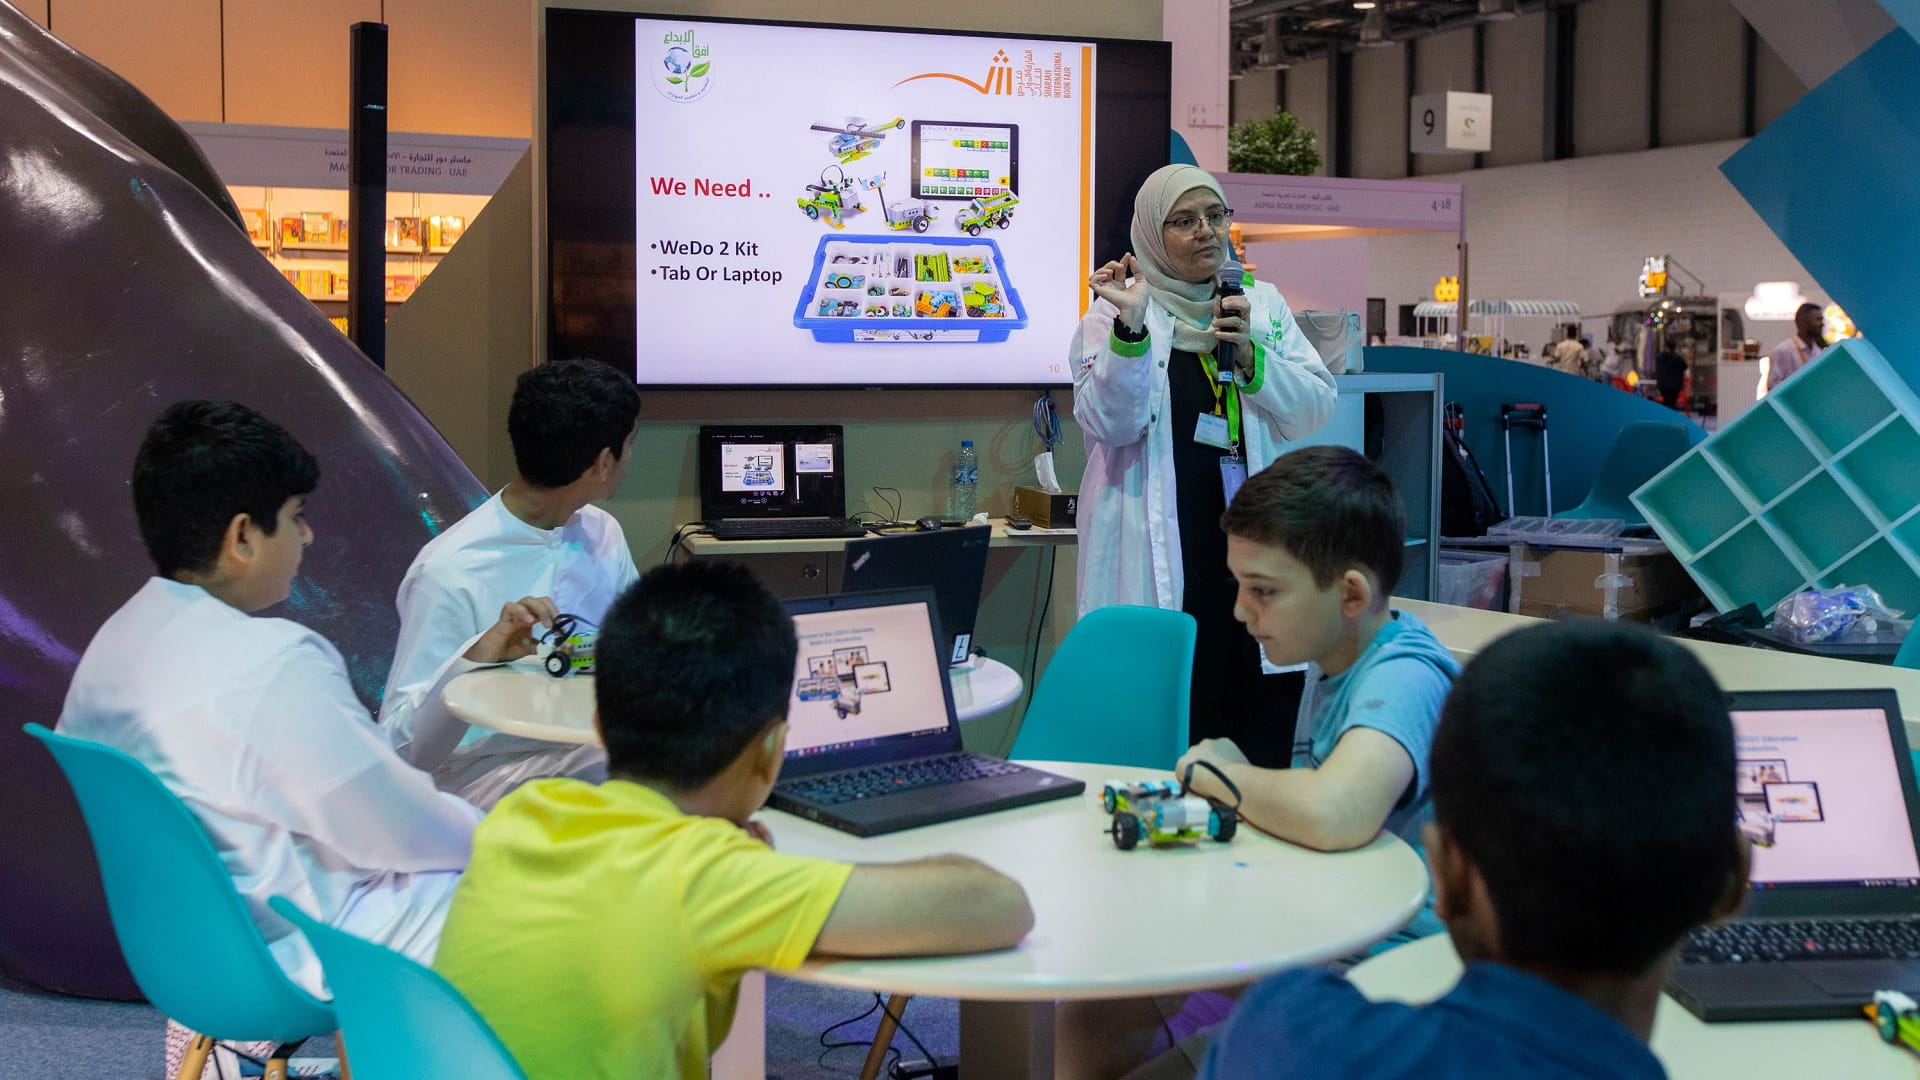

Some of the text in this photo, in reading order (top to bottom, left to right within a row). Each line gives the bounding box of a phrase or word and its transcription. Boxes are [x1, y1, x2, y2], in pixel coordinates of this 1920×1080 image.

[1044, 69, 1052, 98] SHARJAH
[1053, 52, 1062, 98] INTERNATIONAL
[1063, 66, 1071, 99] BOOK FAIR
[1423, 109, 1435, 136] 9
[399, 166, 442, 176] TRADING
[449, 168, 467, 177] UAE
[650, 177, 687, 195] We
[694, 178, 751, 198] Need
[660, 240, 759, 256] WeDo 2 Kit
[659, 265, 783, 285] Tab Or Laptop
[1048, 363, 1060, 373] 10
